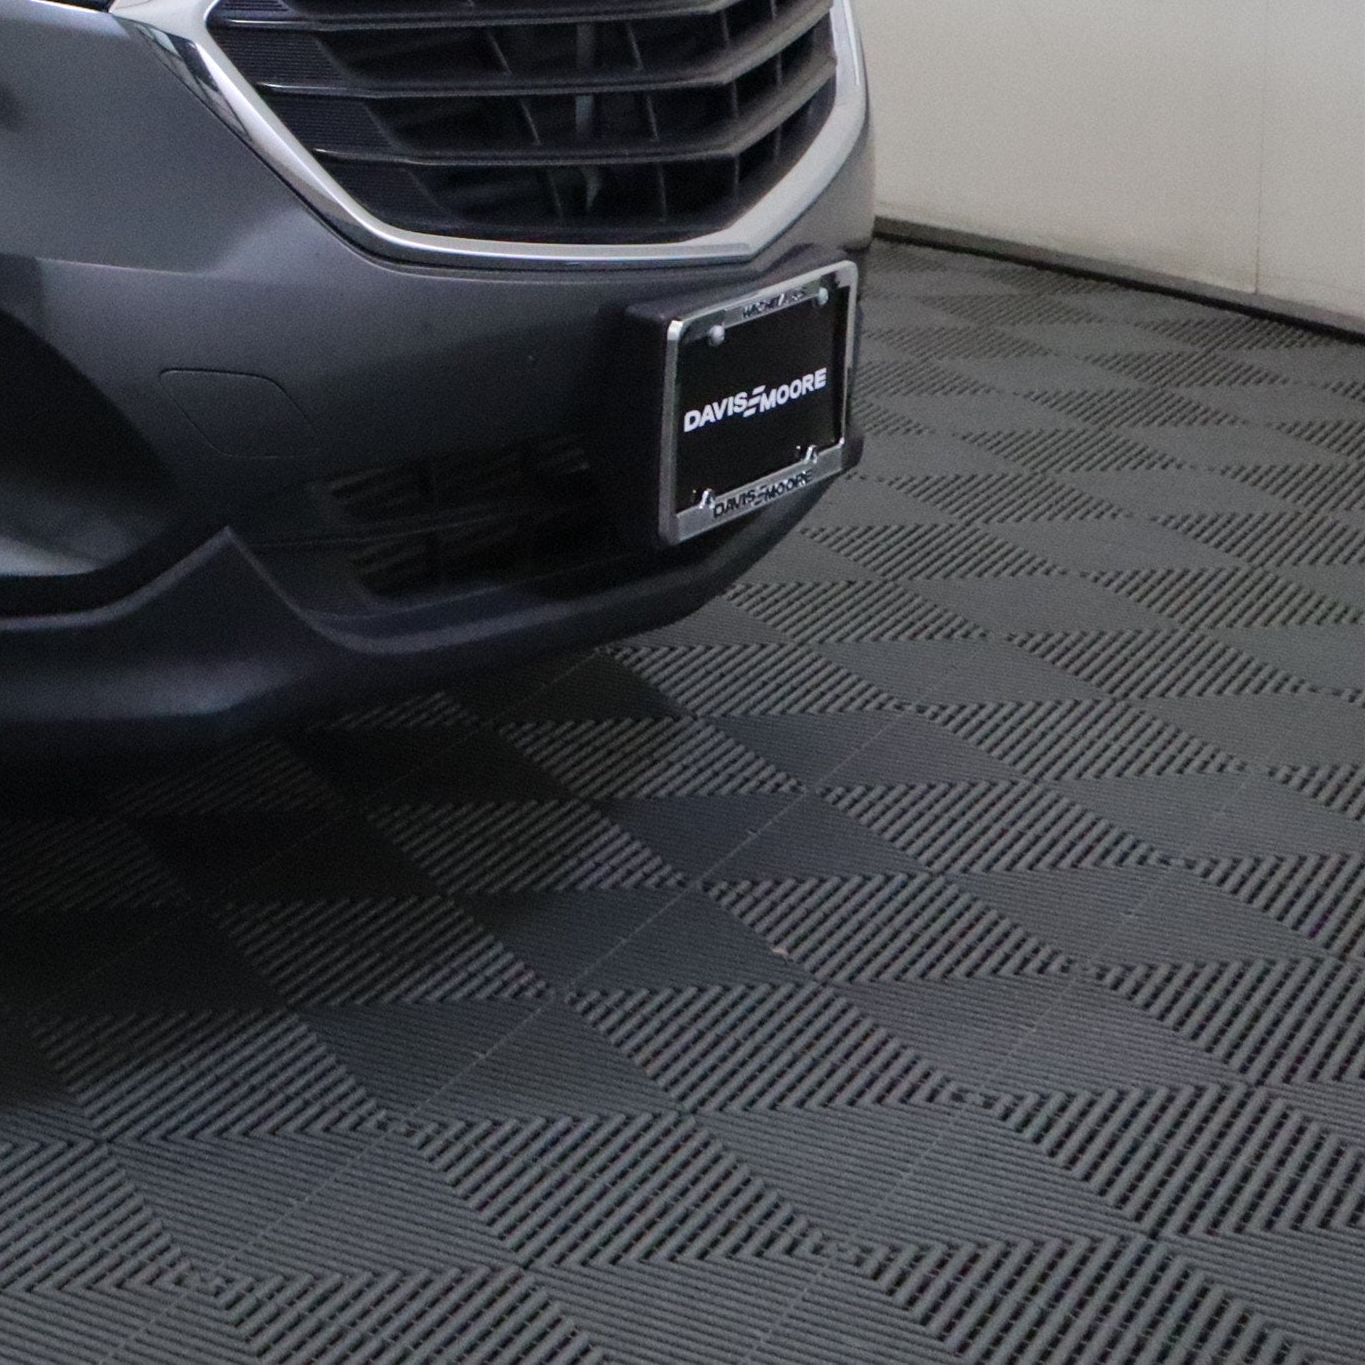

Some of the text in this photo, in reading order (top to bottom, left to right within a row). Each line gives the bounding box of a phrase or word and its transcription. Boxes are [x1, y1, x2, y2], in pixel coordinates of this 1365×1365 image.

[683, 367, 828, 433] DAVIS MOORE
[713, 468, 814, 519] DAVIS MOORE
